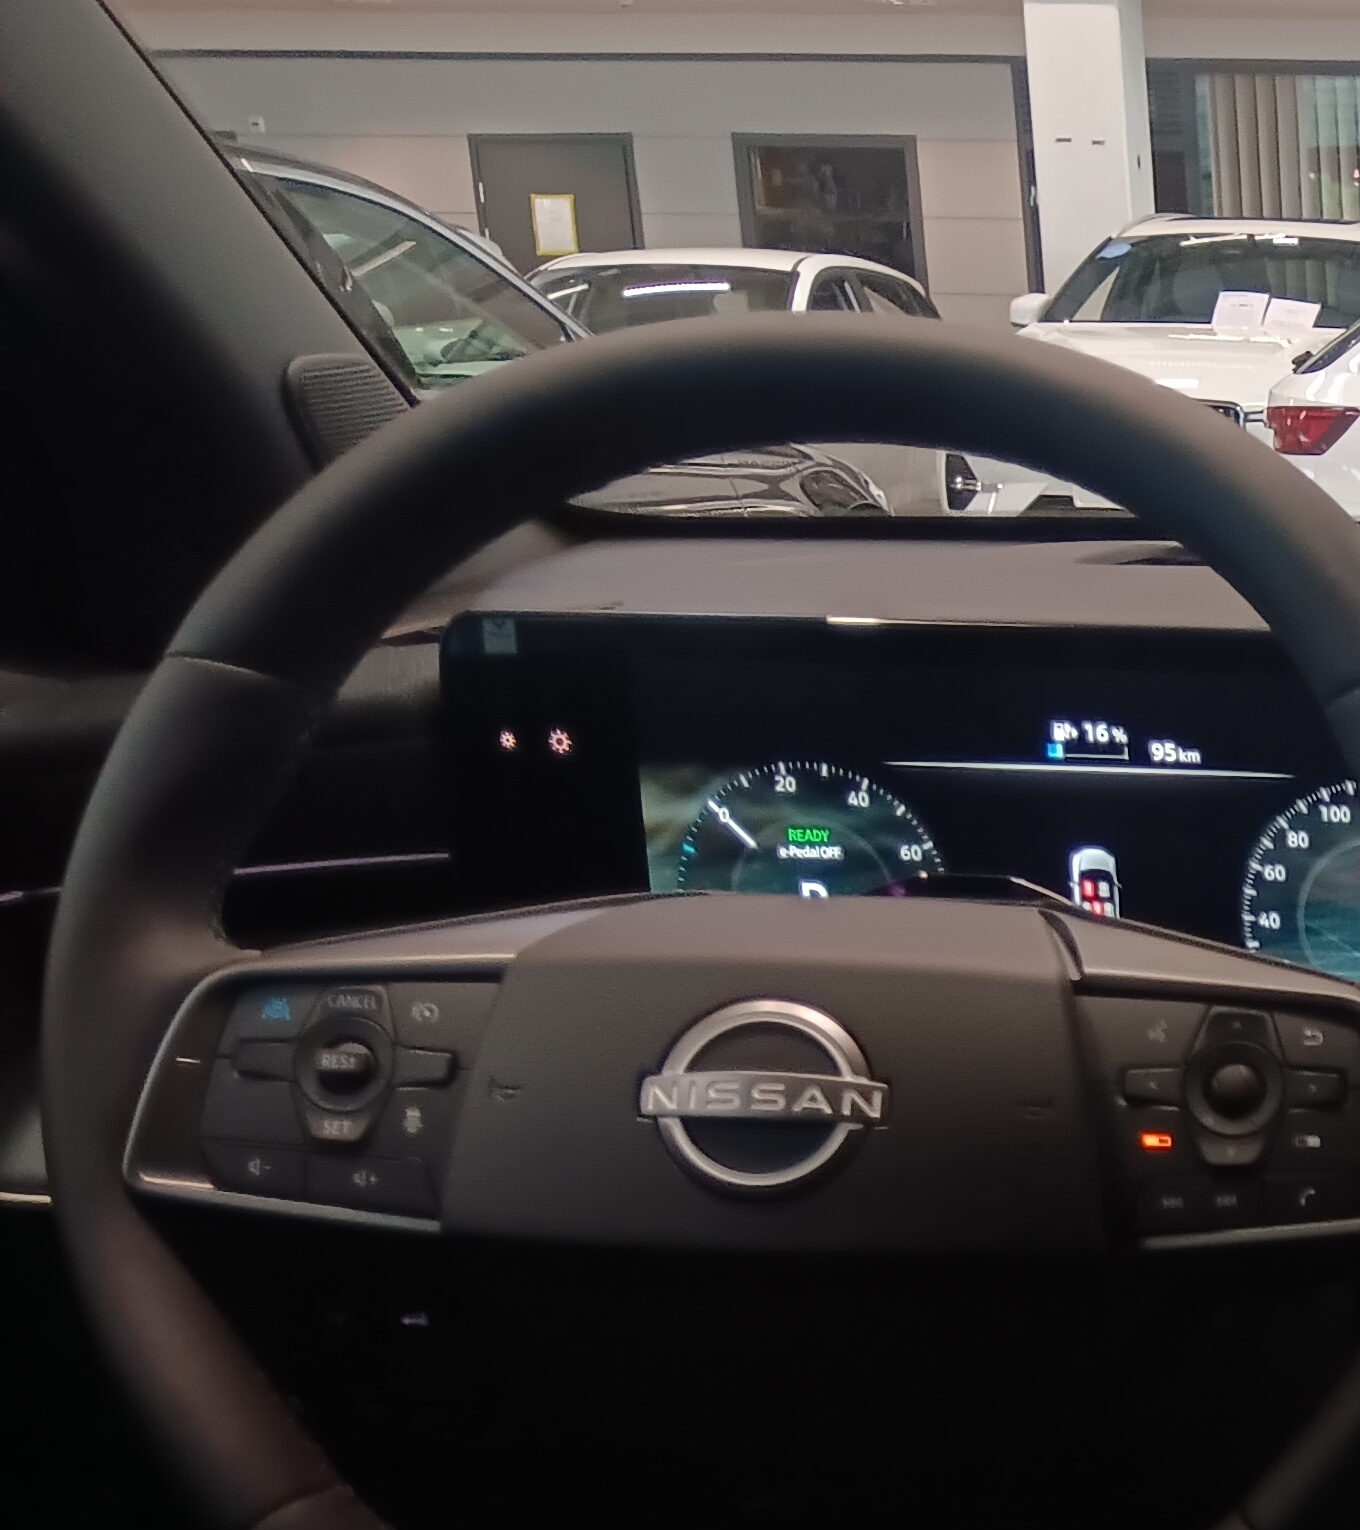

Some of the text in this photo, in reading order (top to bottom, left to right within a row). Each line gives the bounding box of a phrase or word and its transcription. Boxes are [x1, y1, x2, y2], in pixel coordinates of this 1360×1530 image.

[774, 776, 797, 793] 20
[848, 793, 870, 809] 40
[1319, 804, 1351, 824] 100
[787, 828, 830, 842] READY
[1286, 830, 1310, 849] 80
[900, 845, 923, 861] 60
[1263, 863, 1287, 882] 60
[1257, 911, 1282, 930] 40
[646, 1079, 884, 1119] NISSAN
